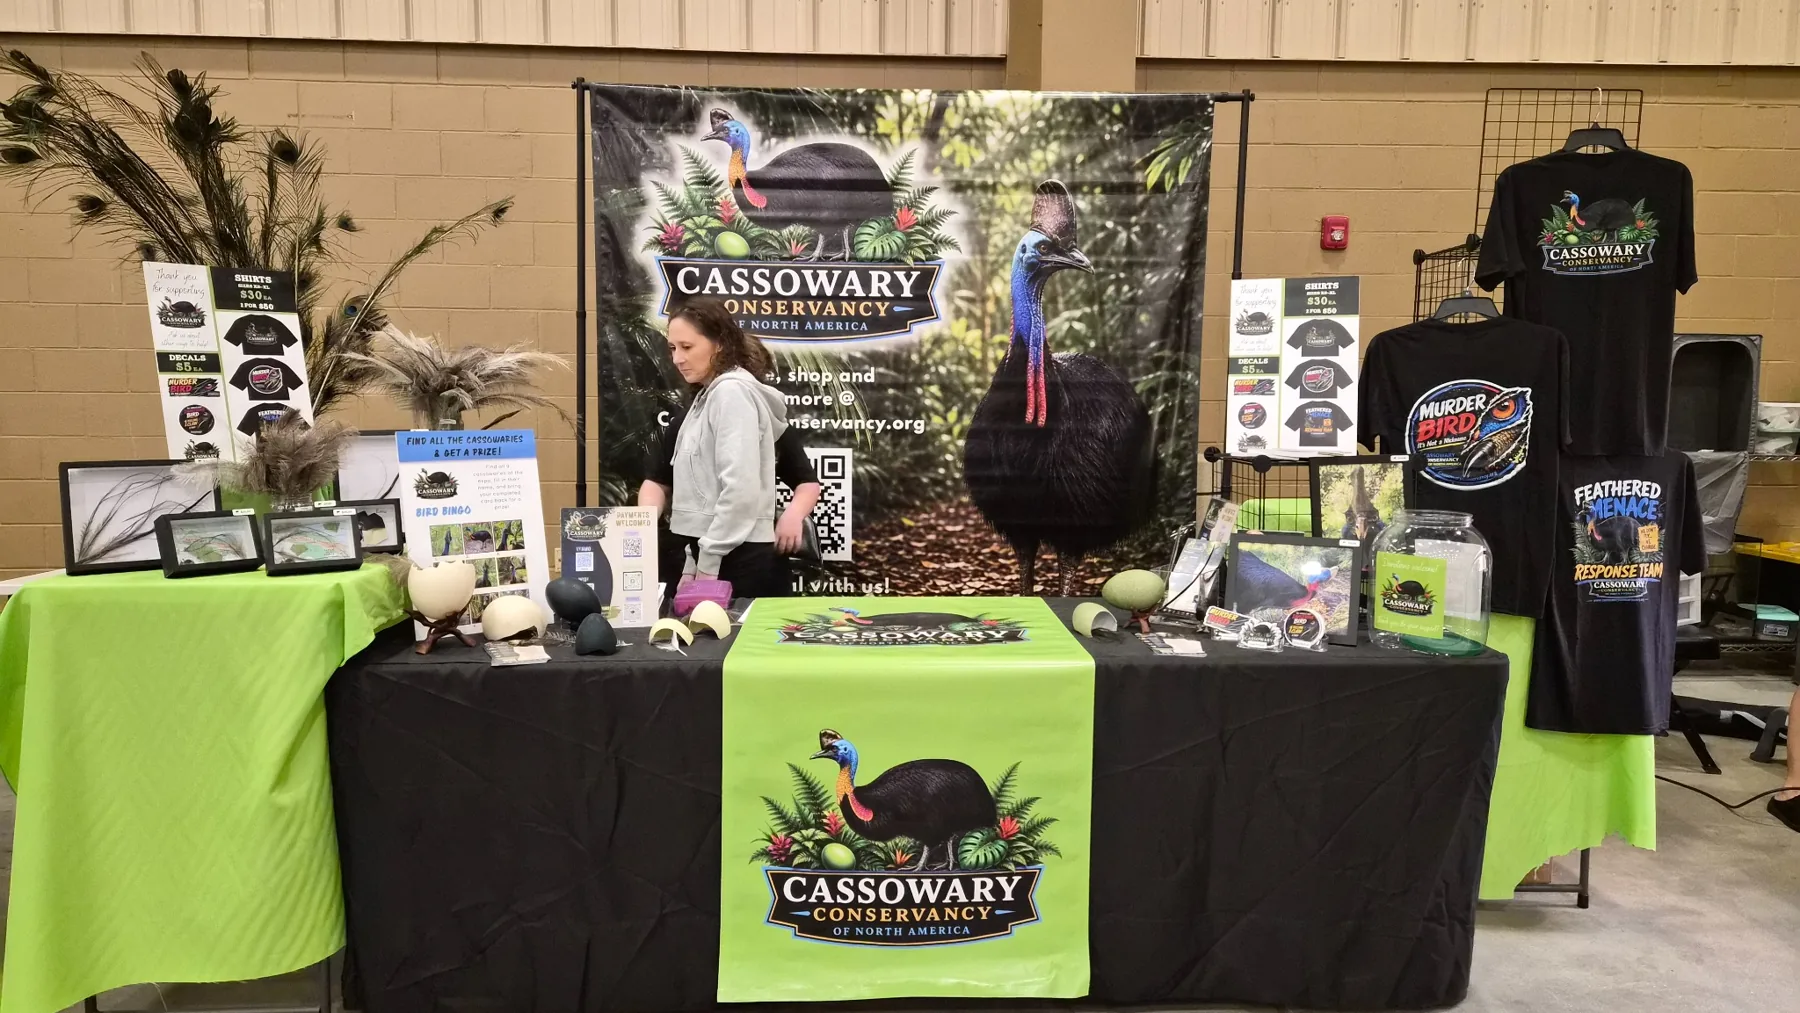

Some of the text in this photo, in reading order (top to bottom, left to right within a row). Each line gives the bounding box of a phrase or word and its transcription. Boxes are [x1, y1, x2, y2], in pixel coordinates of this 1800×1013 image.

[1549, 244, 1646, 260] CASSOWARY
[1562, 256, 1633, 267] CONSERVANCY
[156, 267, 197, 285] Thank you
[234, 274, 272, 284] SHIRTS
[676, 266, 921, 298] CASSOWARY
[152, 281, 206, 299] for supporting
[1304, 282, 1340, 290] SHIRTS
[240, 289, 263, 300] $30
[258, 303, 275, 311] $50
[1307, 296, 1328, 306] $30
[751, 320, 799, 330] NORTH
[804, 320, 868, 331] AMERICA
[168, 354, 207, 362] DECALS
[175, 362, 193, 372] $5
[1242, 365, 1256, 374] $5
[787, 366, 834, 385] shop
[838, 367, 875, 383] and
[168, 378, 198, 386] MURDER
[784, 390, 856, 406] more @
[1419, 393, 1487, 421] MURDER
[1416, 412, 1476, 443] BIRD
[406, 435, 524, 446] FIND ALL THE CASSOWARIES
[434, 446, 502, 458] & GET A PRIZE!
[1574, 479, 1661, 506] FEATHERED
[415, 505, 472, 517] BIRD BINGO
[1588, 496, 1660, 520] MENACE
[616, 511, 650, 519] PAYMENTS
[1574, 562, 1664, 581] RESPONSE TEAM
[809, 577, 855, 593] with
[861, 577, 891, 594] us!
[1384, 598, 1430, 611] CASSOWARY
[1208, 608, 1239, 621] MURDER
[793, 630, 1009, 639] CASSOWARY
[783, 875, 1022, 905] CASSOWARY
[812, 906, 992, 923] CONSERVANCY
[833, 925, 970, 936] OF NORTH AMERICA
